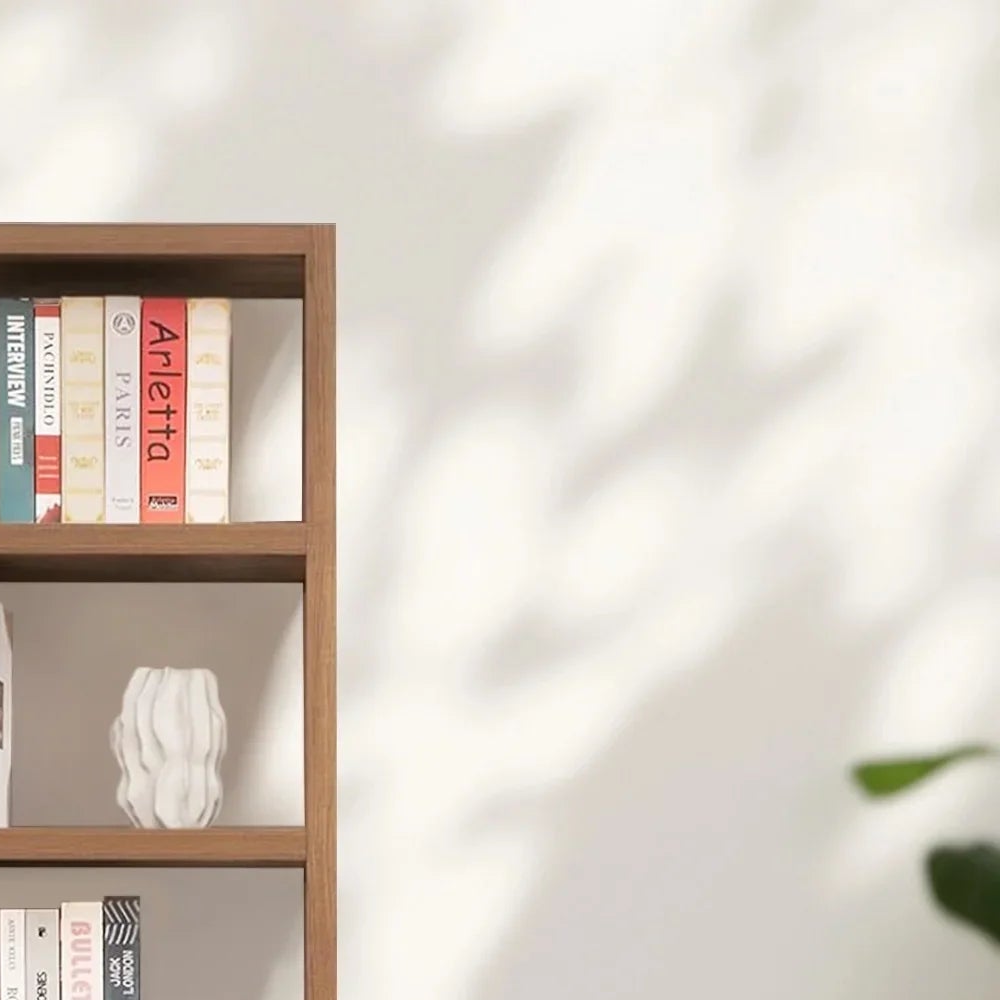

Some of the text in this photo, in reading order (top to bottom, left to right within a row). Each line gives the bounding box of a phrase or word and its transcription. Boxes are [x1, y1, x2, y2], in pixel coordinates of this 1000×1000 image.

[6, 315, 26, 408] INTERVIEW
[147, 320, 183, 462] Arletta
[115, 372, 132, 448] PARIS
[109, 956, 121, 988] JACK
[122, 949, 135, 995] LONDON
